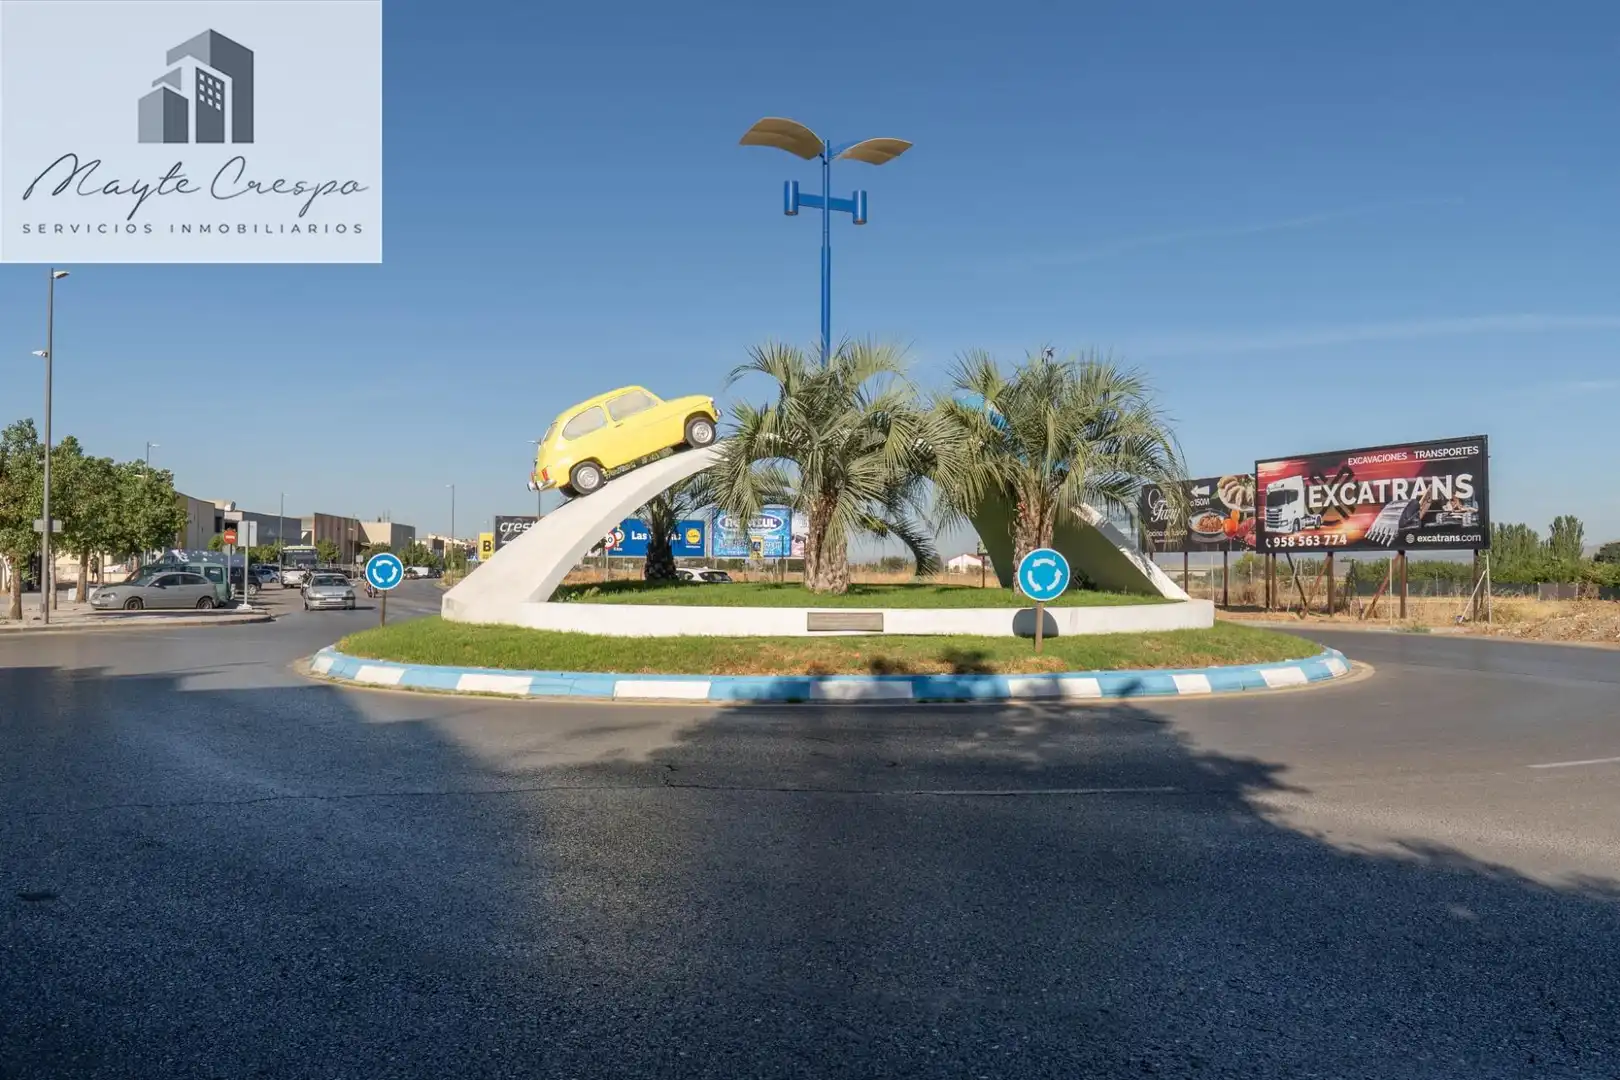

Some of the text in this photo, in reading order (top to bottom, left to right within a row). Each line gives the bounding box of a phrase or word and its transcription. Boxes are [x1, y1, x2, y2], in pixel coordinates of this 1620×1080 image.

[1347, 446, 1479, 466] EXCAVACIONES TRANSPORTES
[1308, 473, 1474, 508] EXCATRANS
[631, 530, 648, 540] Las
[1273, 534, 1347, 548] 958 563 774
[1417, 533, 1481, 543] excatrans.com
[483, 540, 492, 552] B
